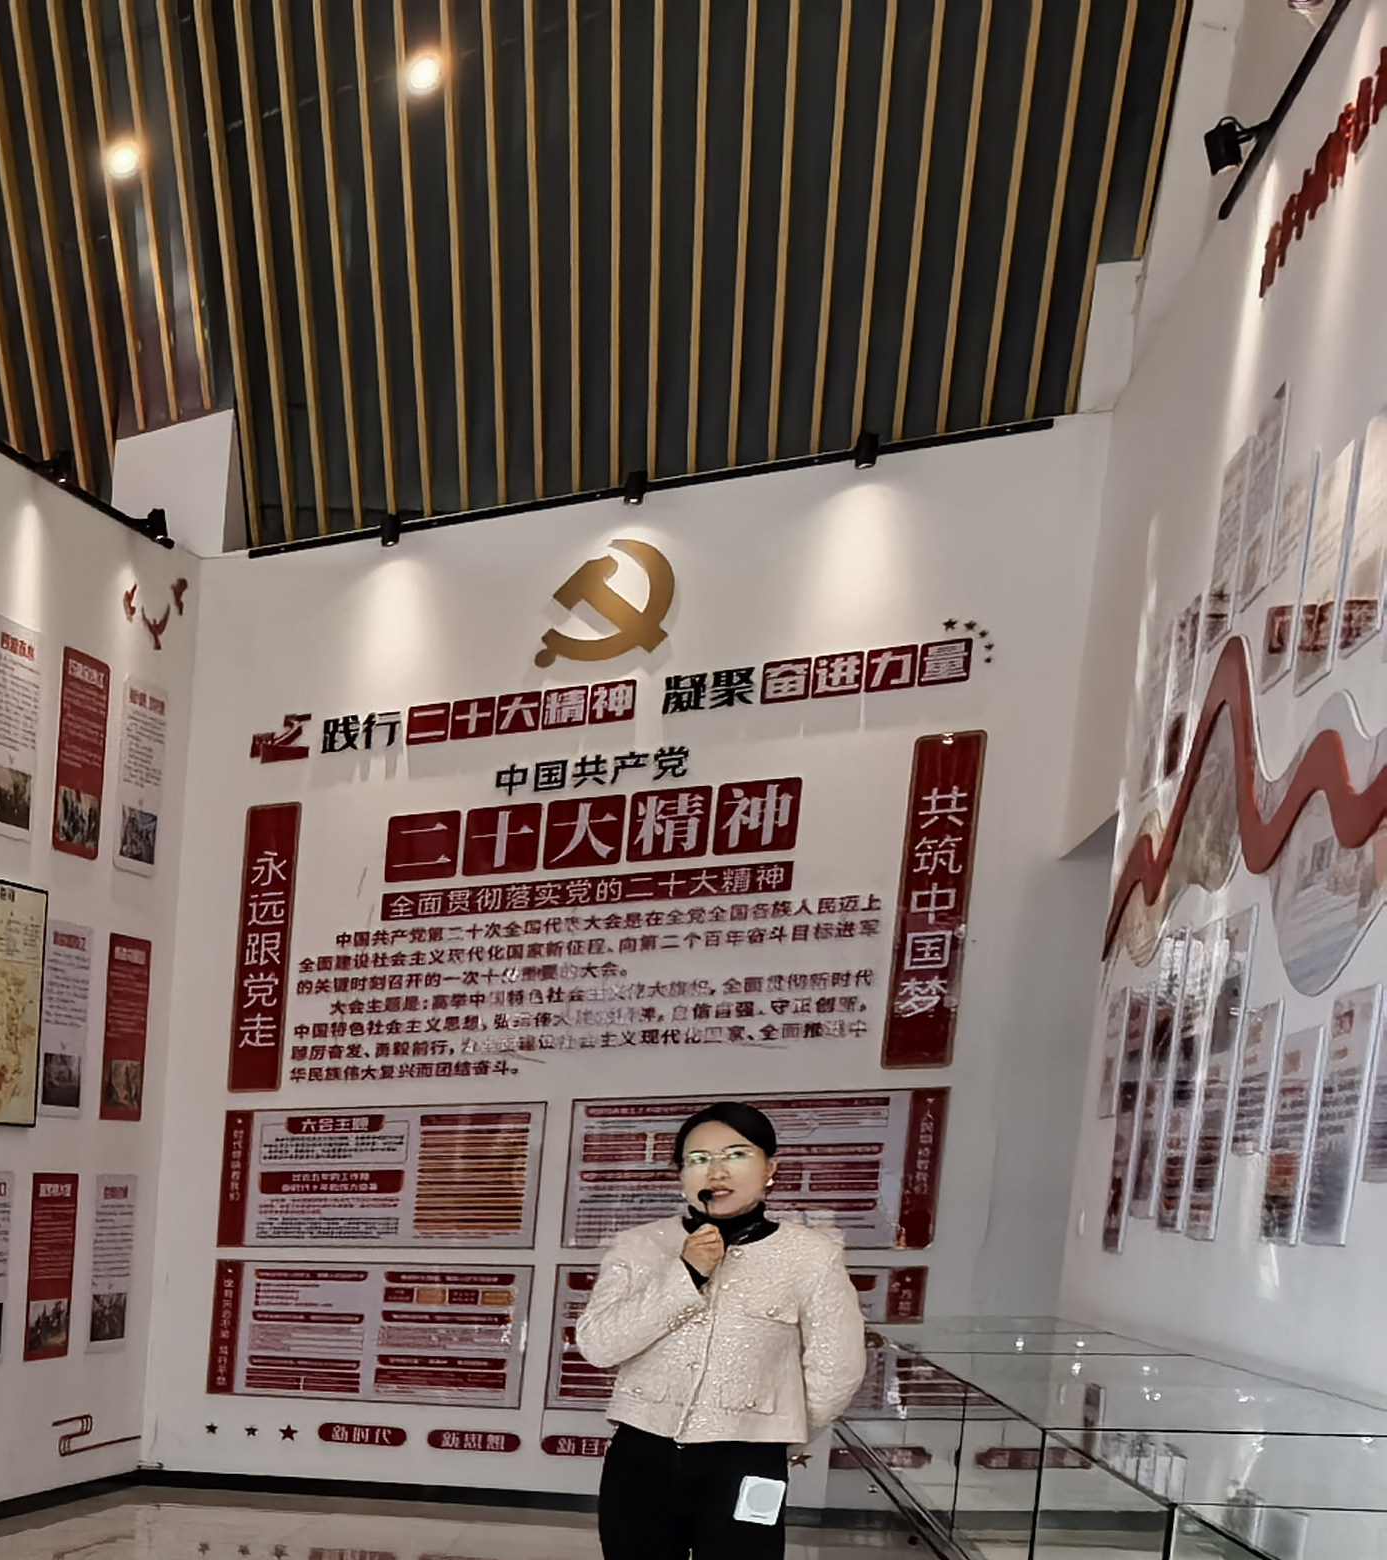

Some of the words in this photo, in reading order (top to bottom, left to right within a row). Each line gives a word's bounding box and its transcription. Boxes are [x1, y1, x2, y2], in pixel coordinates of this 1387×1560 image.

[321, 683, 637, 754] 践行二十大精神
[661, 641, 971, 715] 凝聚奋进力量
[494, 745, 689, 796] 中国共产党
[390, 783, 795, 869] 二十大精神
[388, 864, 785, 920] 全面贯彻落实党的二十大精神
[893, 785, 969, 1018] 共筑中国梦
[238, 850, 288, 1049] 永远跟党走
[331, 1424, 393, 1445] 新时代
[556, 1437, 612, 1456] 新目
